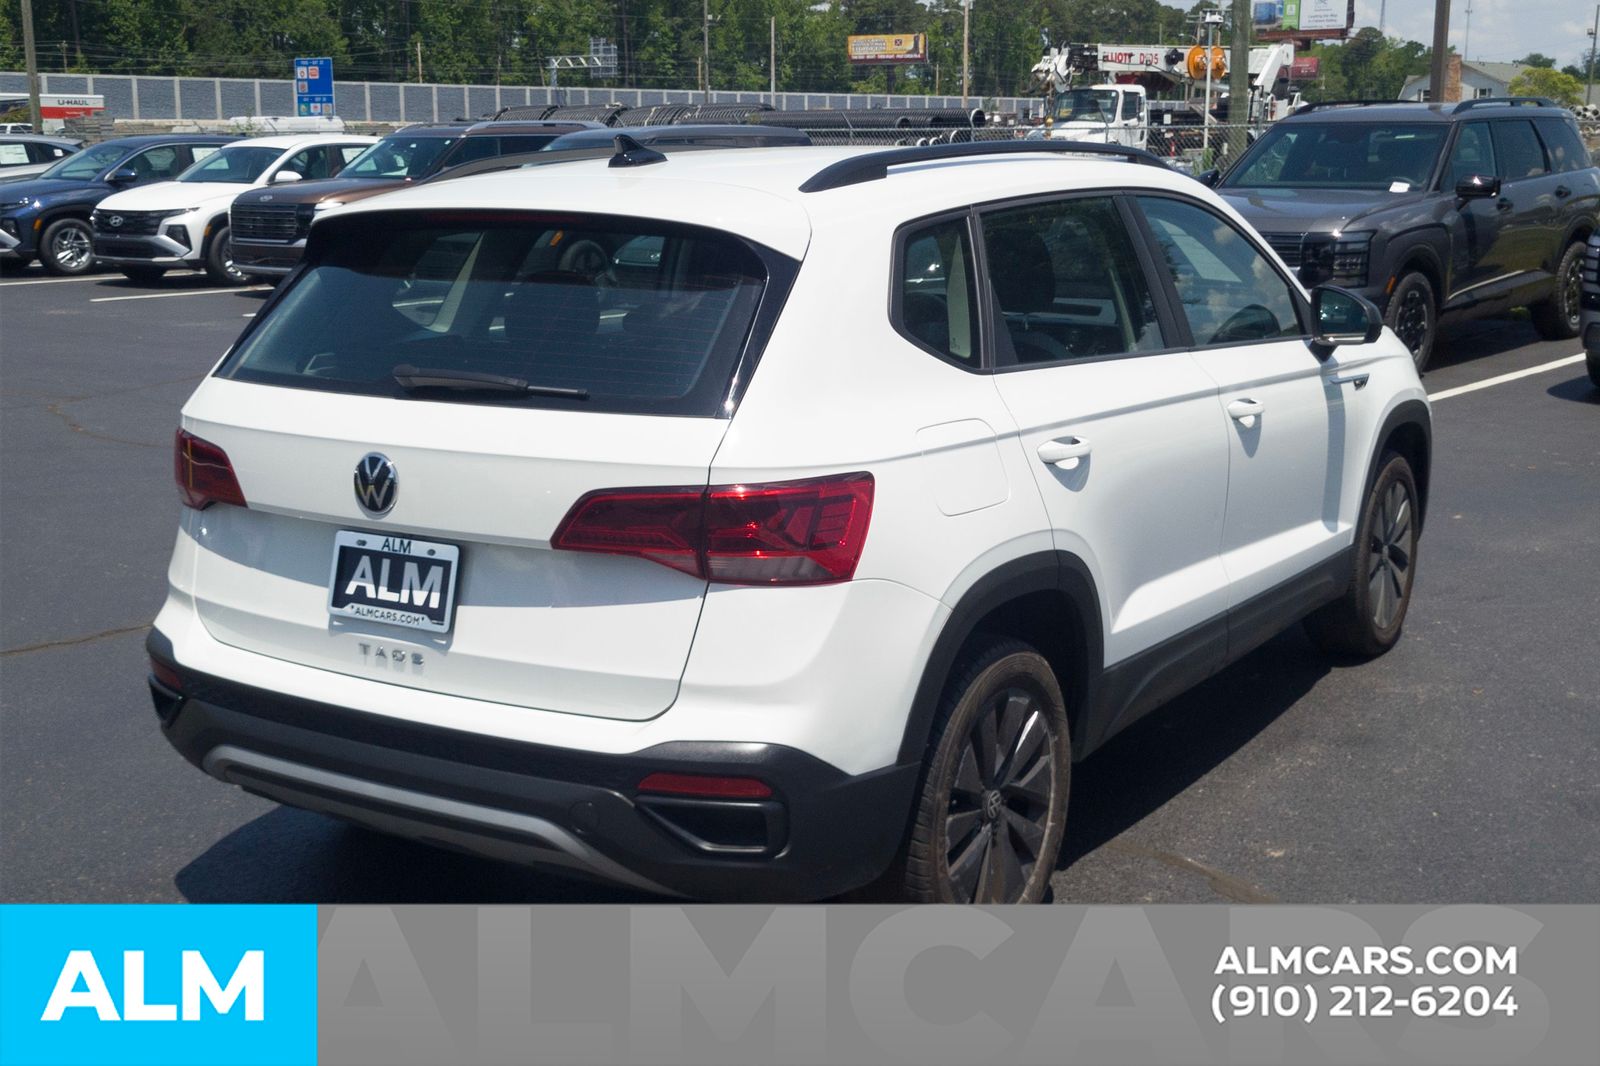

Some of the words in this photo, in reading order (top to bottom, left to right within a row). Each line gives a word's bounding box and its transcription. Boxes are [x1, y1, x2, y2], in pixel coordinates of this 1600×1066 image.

[381, 537, 412, 554] ALM
[345, 555, 444, 609] ALM
[354, 607, 420, 625] ALMCARS.COM
